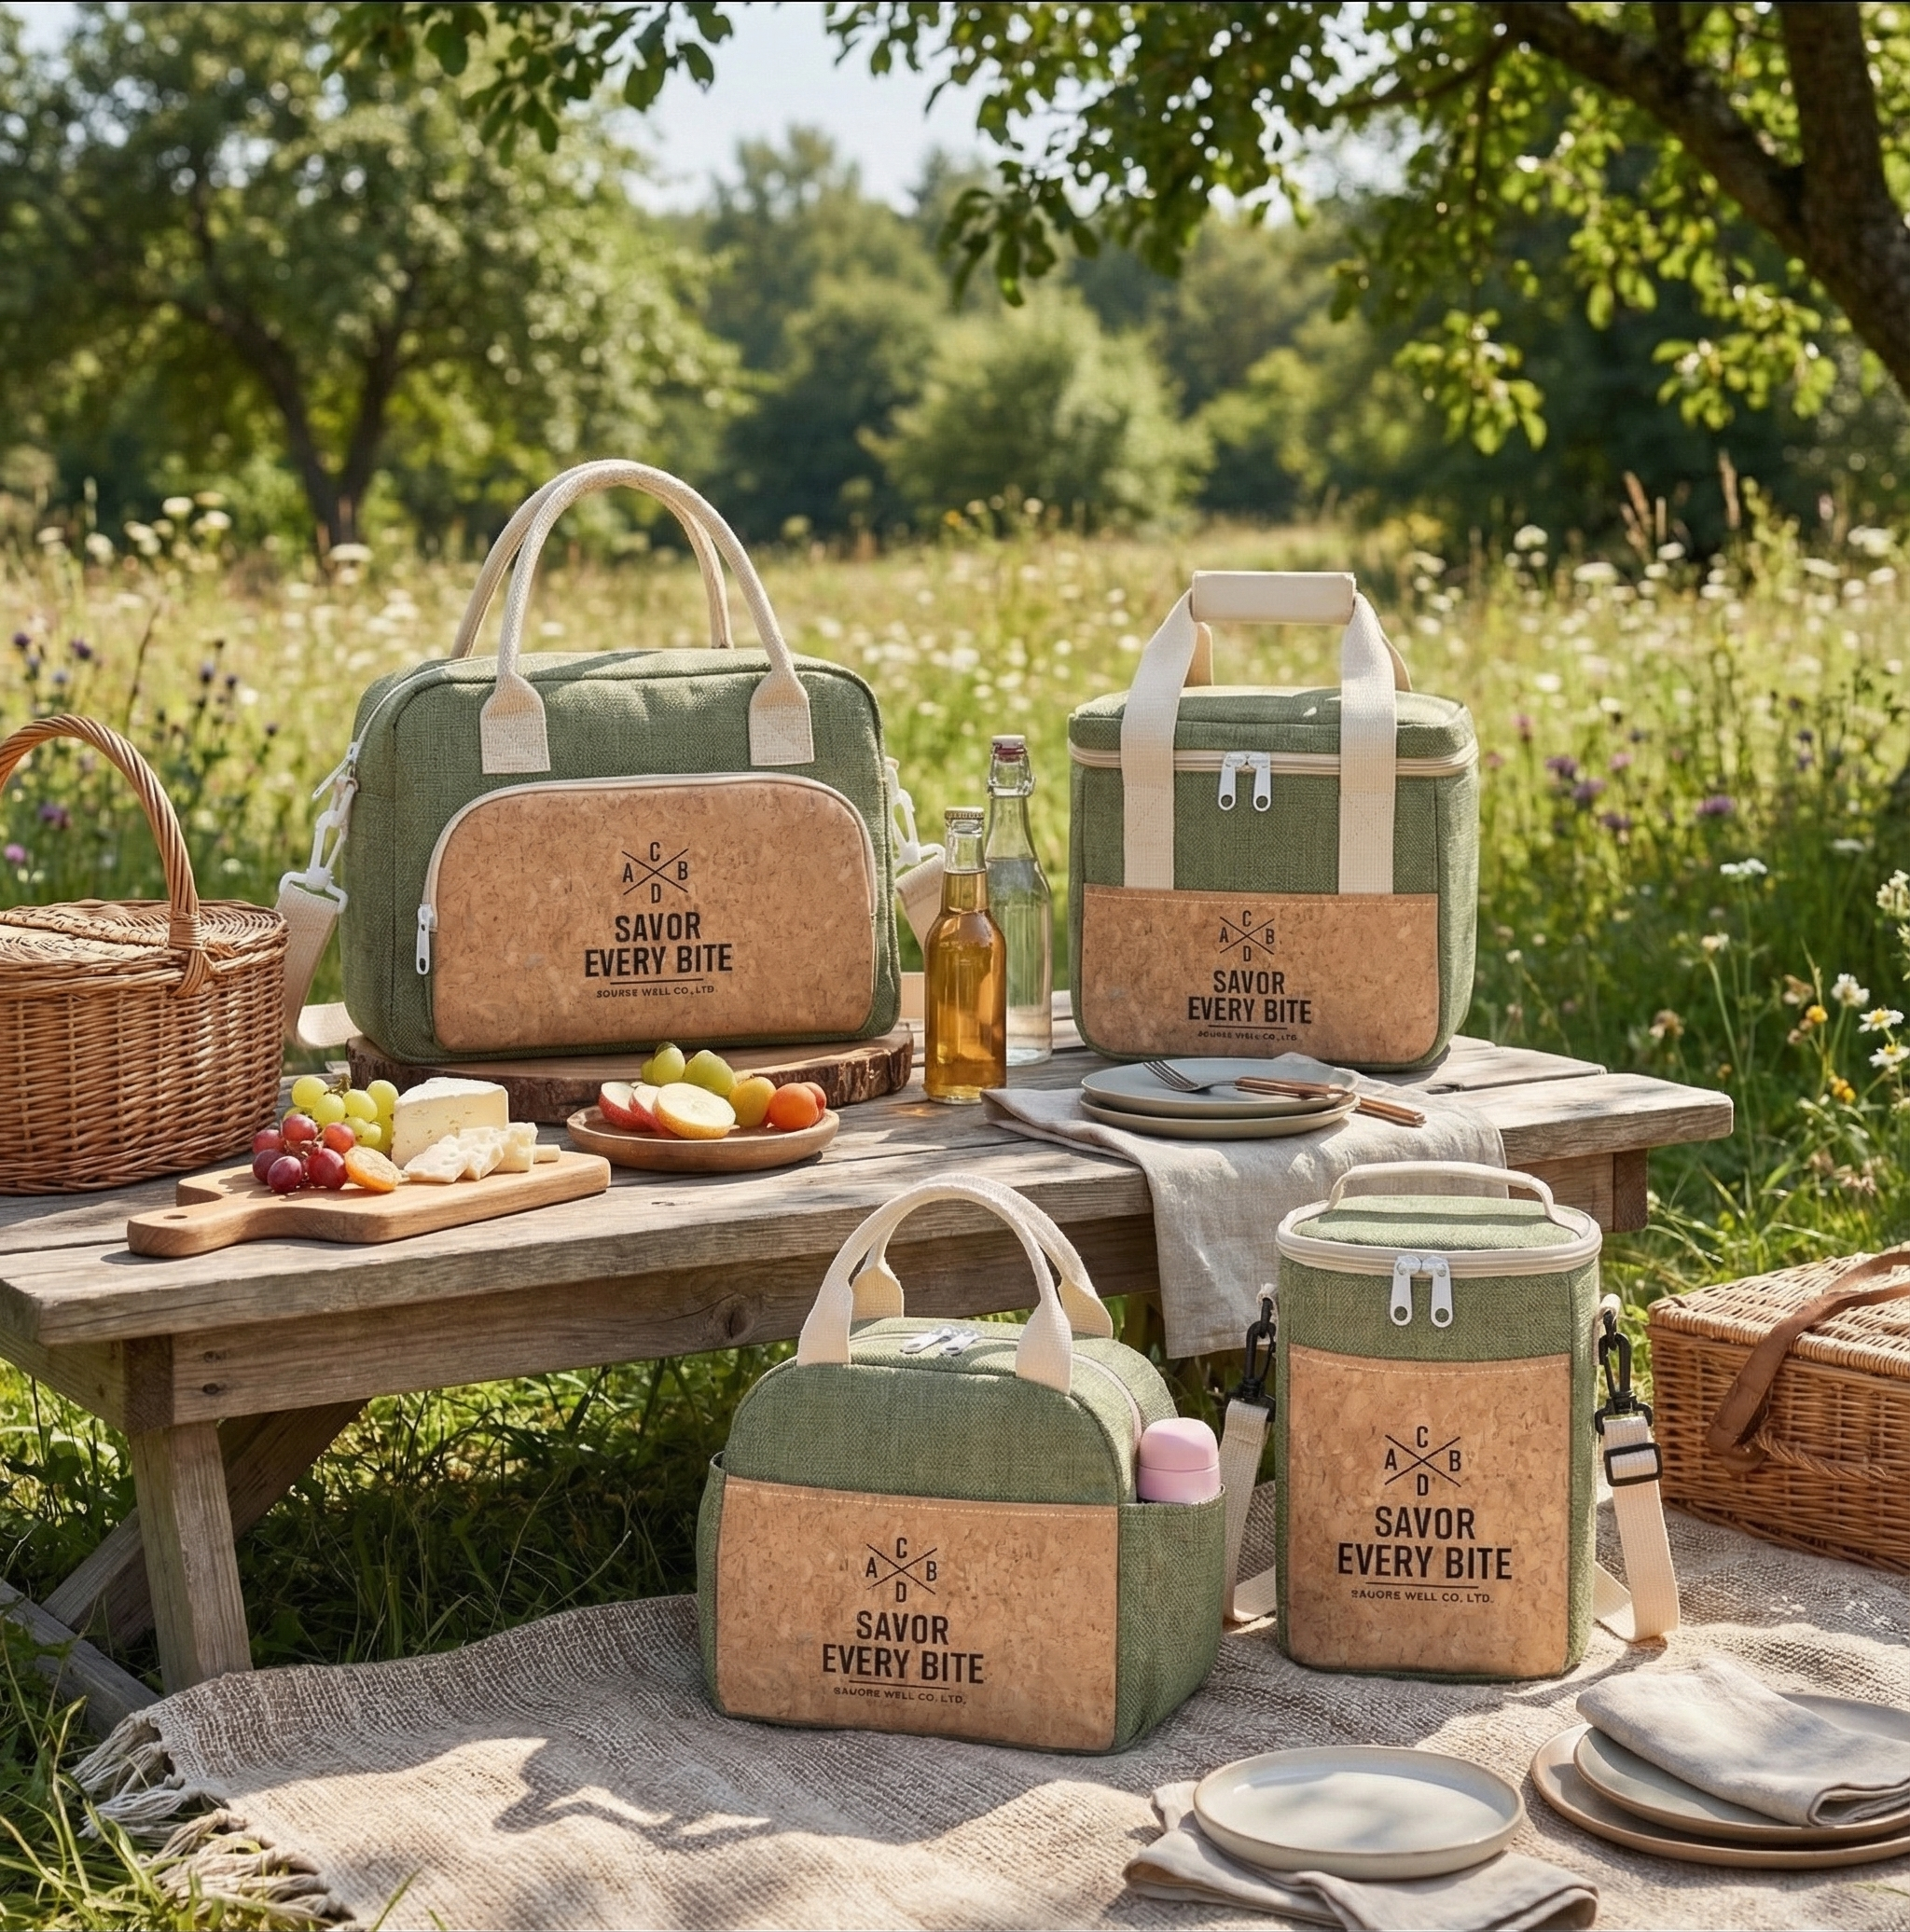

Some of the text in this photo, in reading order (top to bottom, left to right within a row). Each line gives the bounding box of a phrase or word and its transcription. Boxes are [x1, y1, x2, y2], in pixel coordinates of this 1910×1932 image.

[649, 841, 661, 862] C
[622, 861, 688, 883] A B
[651, 883, 661, 904] D
[615, 911, 701, 943] SAVOR
[1242, 910, 1252, 927] C
[1219, 927, 1275, 945] A B
[585, 944, 733, 977] EVERY BITE
[1243, 945, 1252, 961] D
[1213, 970, 1285, 995] SAVOR
[1188, 996, 1312, 1024] EVERY BITE
[1417, 1426, 1429, 1448] C
[1384, 1448, 1461, 1471] A B
[1417, 1473, 1429, 1496] D
[1375, 1506, 1475, 1539] SAVOR
[896, 1537, 907, 1559] C
[865, 1556, 937, 1581] A B
[1337, 1542, 1513, 1580] EVERY BITE
[895, 1580, 907, 1603] D
[1405, 1592, 1438, 1602] WELL
[856, 1610, 949, 1645] SAVOR
[823, 1643, 984, 1684] EVERY BITE
[884, 1690, 915, 1701] WELL
